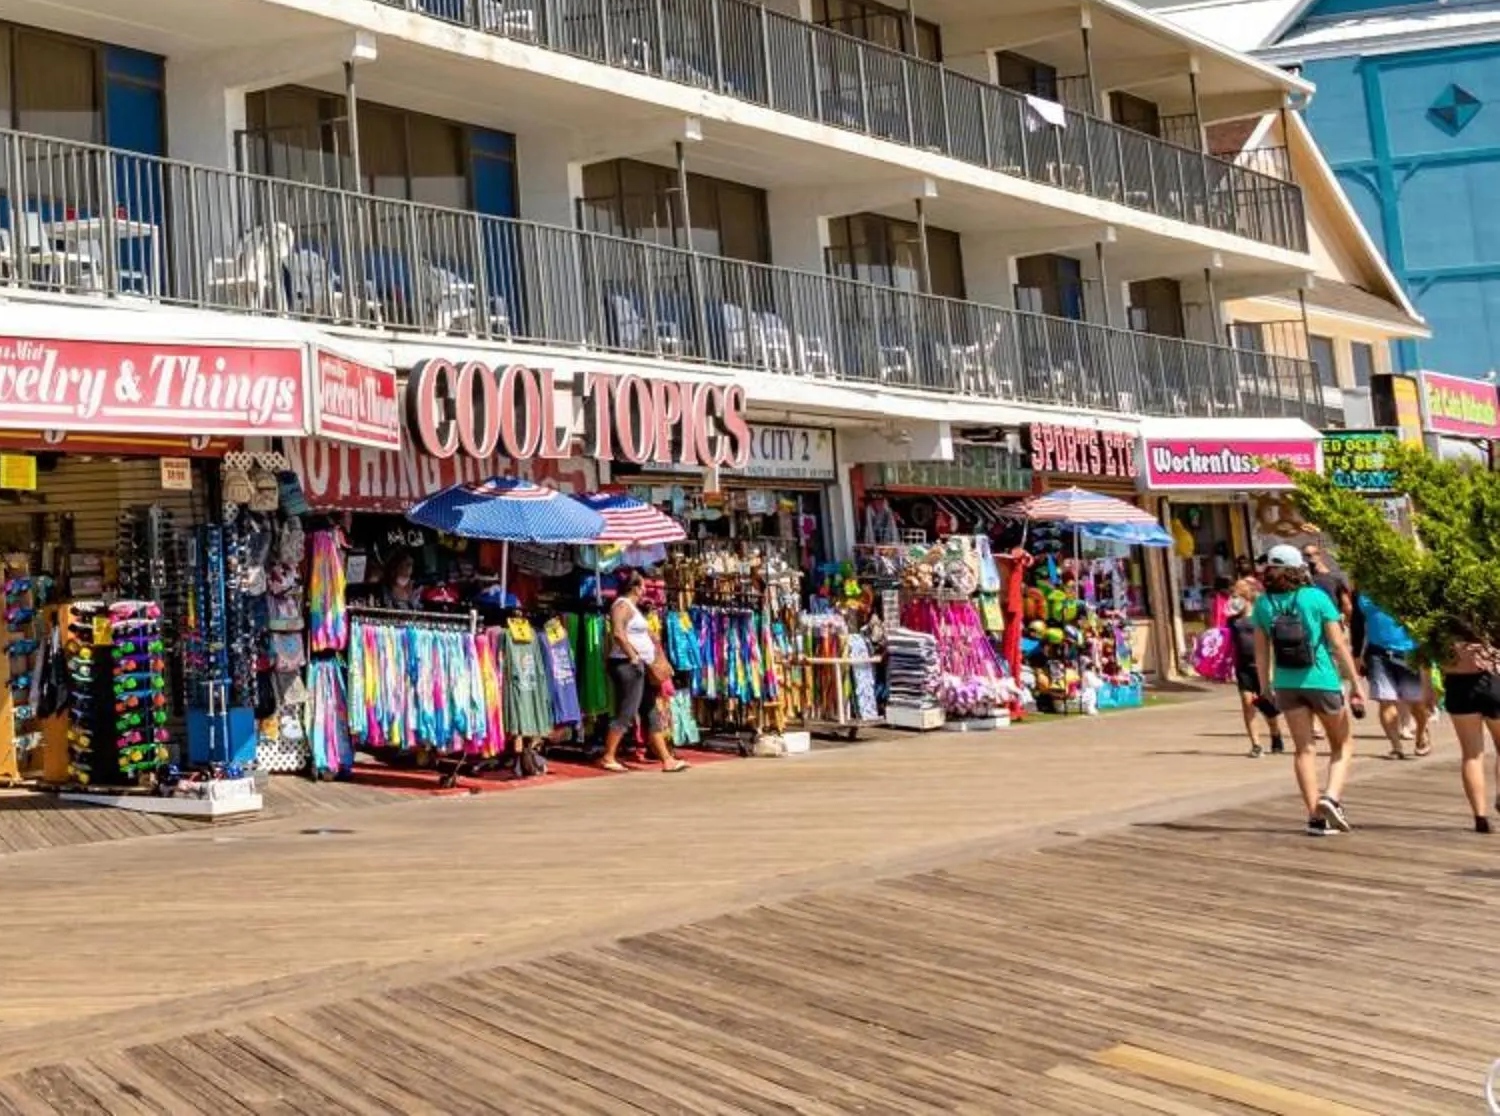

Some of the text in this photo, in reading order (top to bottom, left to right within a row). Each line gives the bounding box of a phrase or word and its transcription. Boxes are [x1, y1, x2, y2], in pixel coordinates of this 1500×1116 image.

[114, 359, 143, 404] &
[148, 354, 297, 426] Things
[410, 356, 572, 459] COOL
[580, 371, 751, 469] TOPICS
[760, 427, 798, 461] CITY
[800, 431, 810, 462] 2
[1030, 422, 1100, 475] SPORTS
